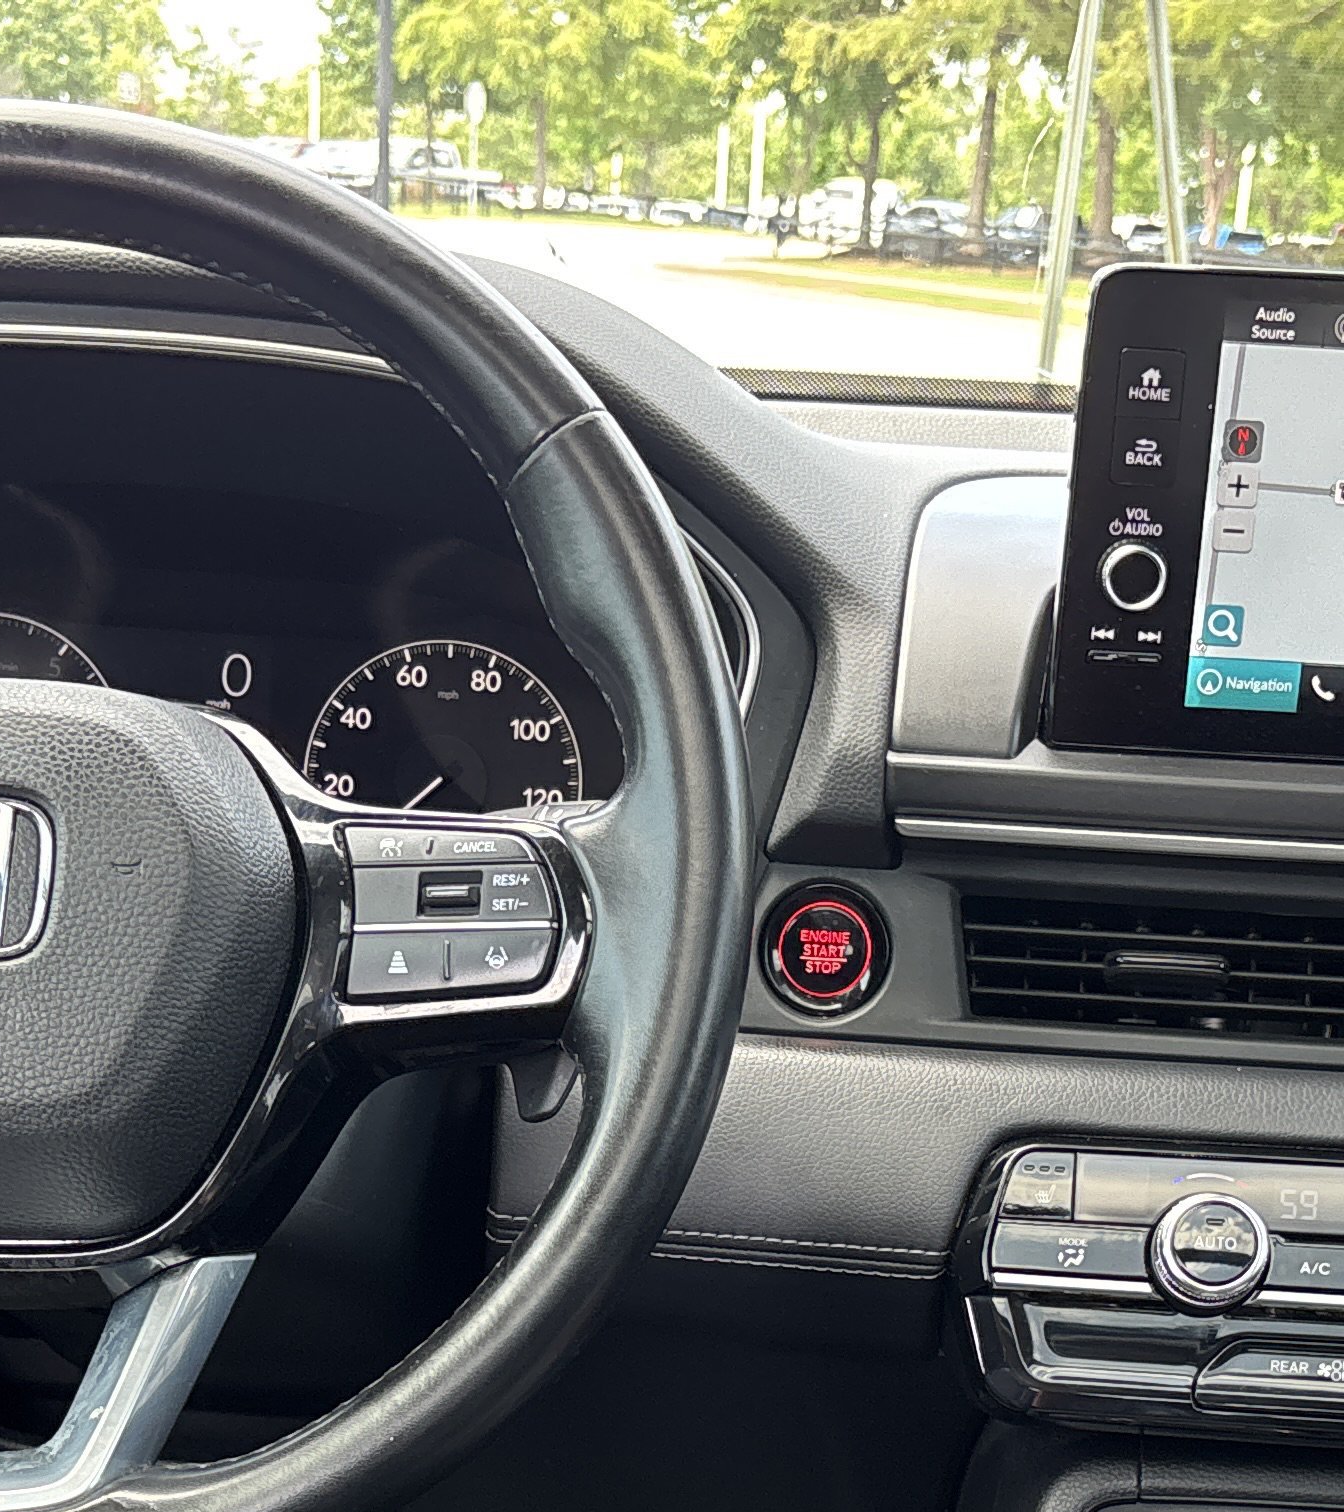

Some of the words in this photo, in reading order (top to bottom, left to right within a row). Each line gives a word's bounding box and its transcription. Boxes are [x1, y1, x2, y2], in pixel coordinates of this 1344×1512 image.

[1255, 307, 1296, 323] Audio
[1251, 326, 1296, 341] Source
[1128, 387, 1171, 402] HOME
[1125, 452, 1162, 467] BACK
[1126, 508, 1150, 521] VOL
[1123, 522, 1162, 536] AUDIO
[221, 653, 252, 697] 0
[396, 665, 427, 687] 60
[470, 671, 501, 692] 80
[1226, 676, 1292, 693] Navigation
[340, 707, 371, 729] 40
[510, 719, 551, 742] 100
[323, 774, 354, 797] 20
[523, 788, 562, 806] 120
[453, 841, 497, 853] CANCEL
[492, 873, 530, 887] RES/+
[799, 929, 851, 945] ENGINE
[803, 944, 846, 957] START
[805, 961, 841, 974] STOP
[1280, 1190, 1318, 1220] 59
[1058, 1236, 1088, 1248] MODE
[1193, 1235, 1237, 1252] AUTO
[1300, 1261, 1331, 1277] A/C
[1270, 1359, 1308, 1374] REAR
